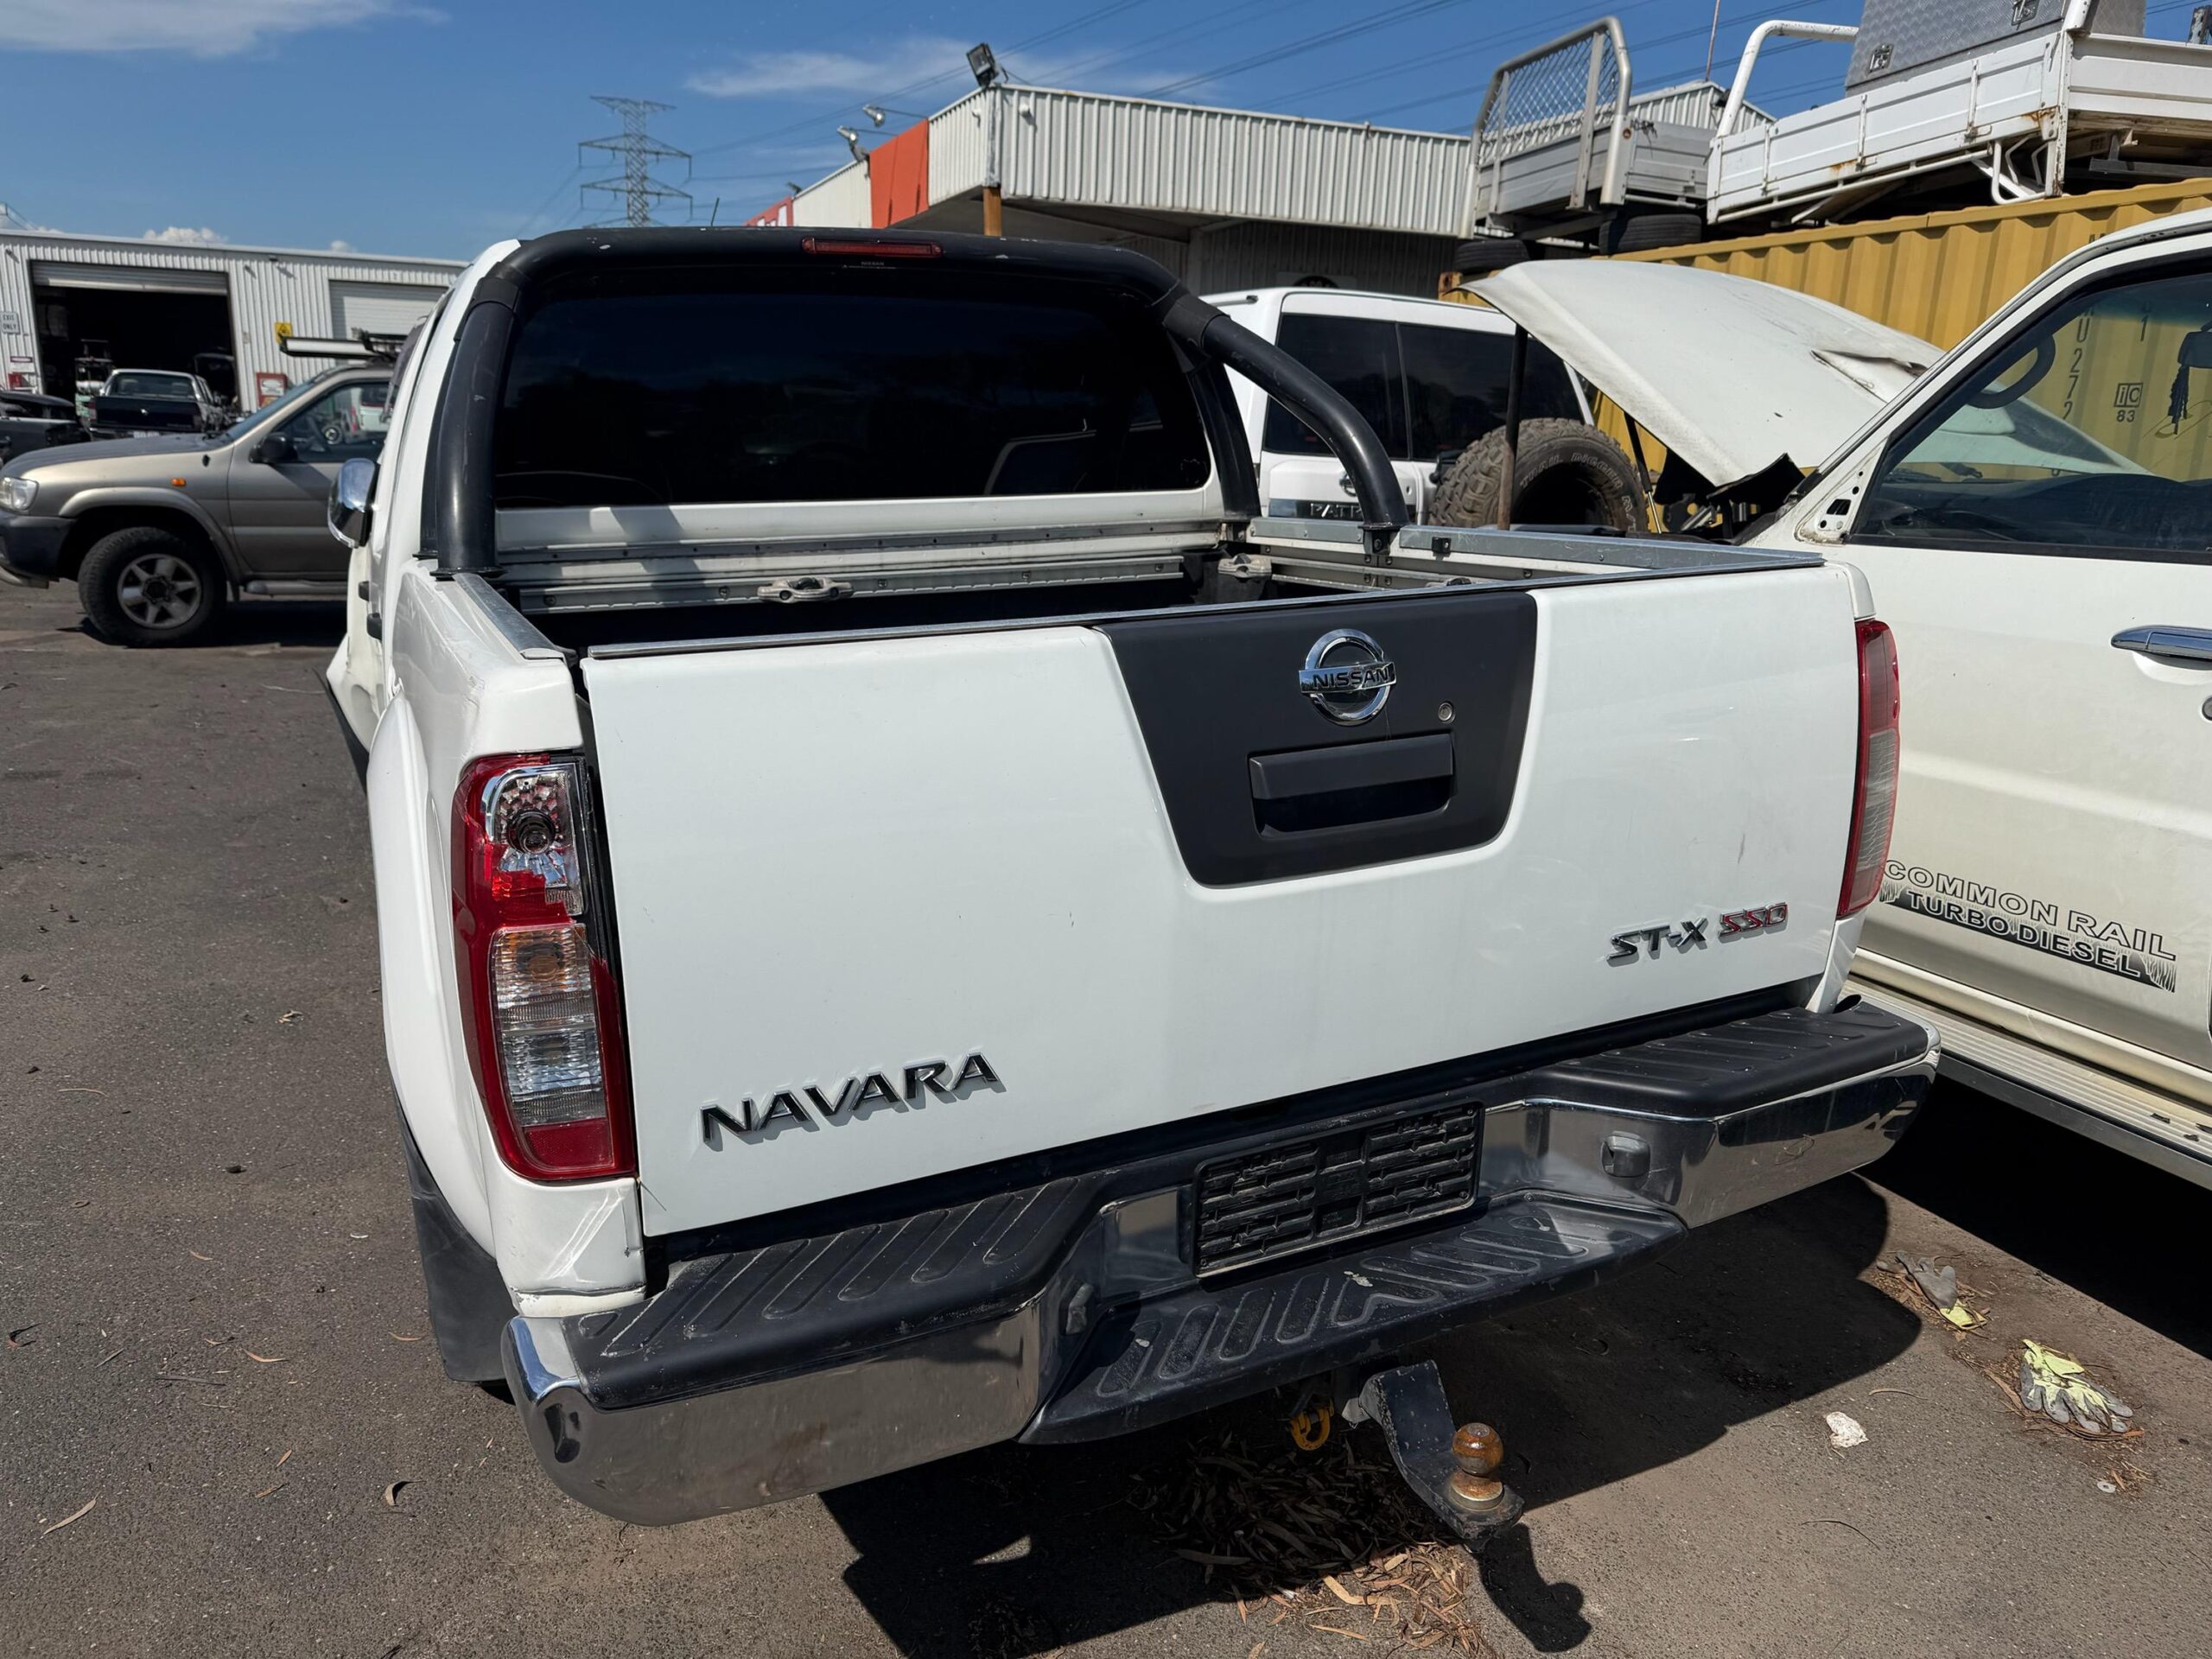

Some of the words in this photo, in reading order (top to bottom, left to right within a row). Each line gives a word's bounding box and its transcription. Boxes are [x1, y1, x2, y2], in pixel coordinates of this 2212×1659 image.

[2116, 410, 2135, 423] 83
[1313, 667, 1389, 688] NISSAN
[1606, 917, 1707, 962] ST-X
[1885, 860, 2058, 926] COMMON
[2067, 910, 2176, 961] RAIL
[1907, 890, 2010, 934] TURBO
[2018, 925, 2140, 976] DIESEL
[700, 1050, 999, 1142] NAVARA
